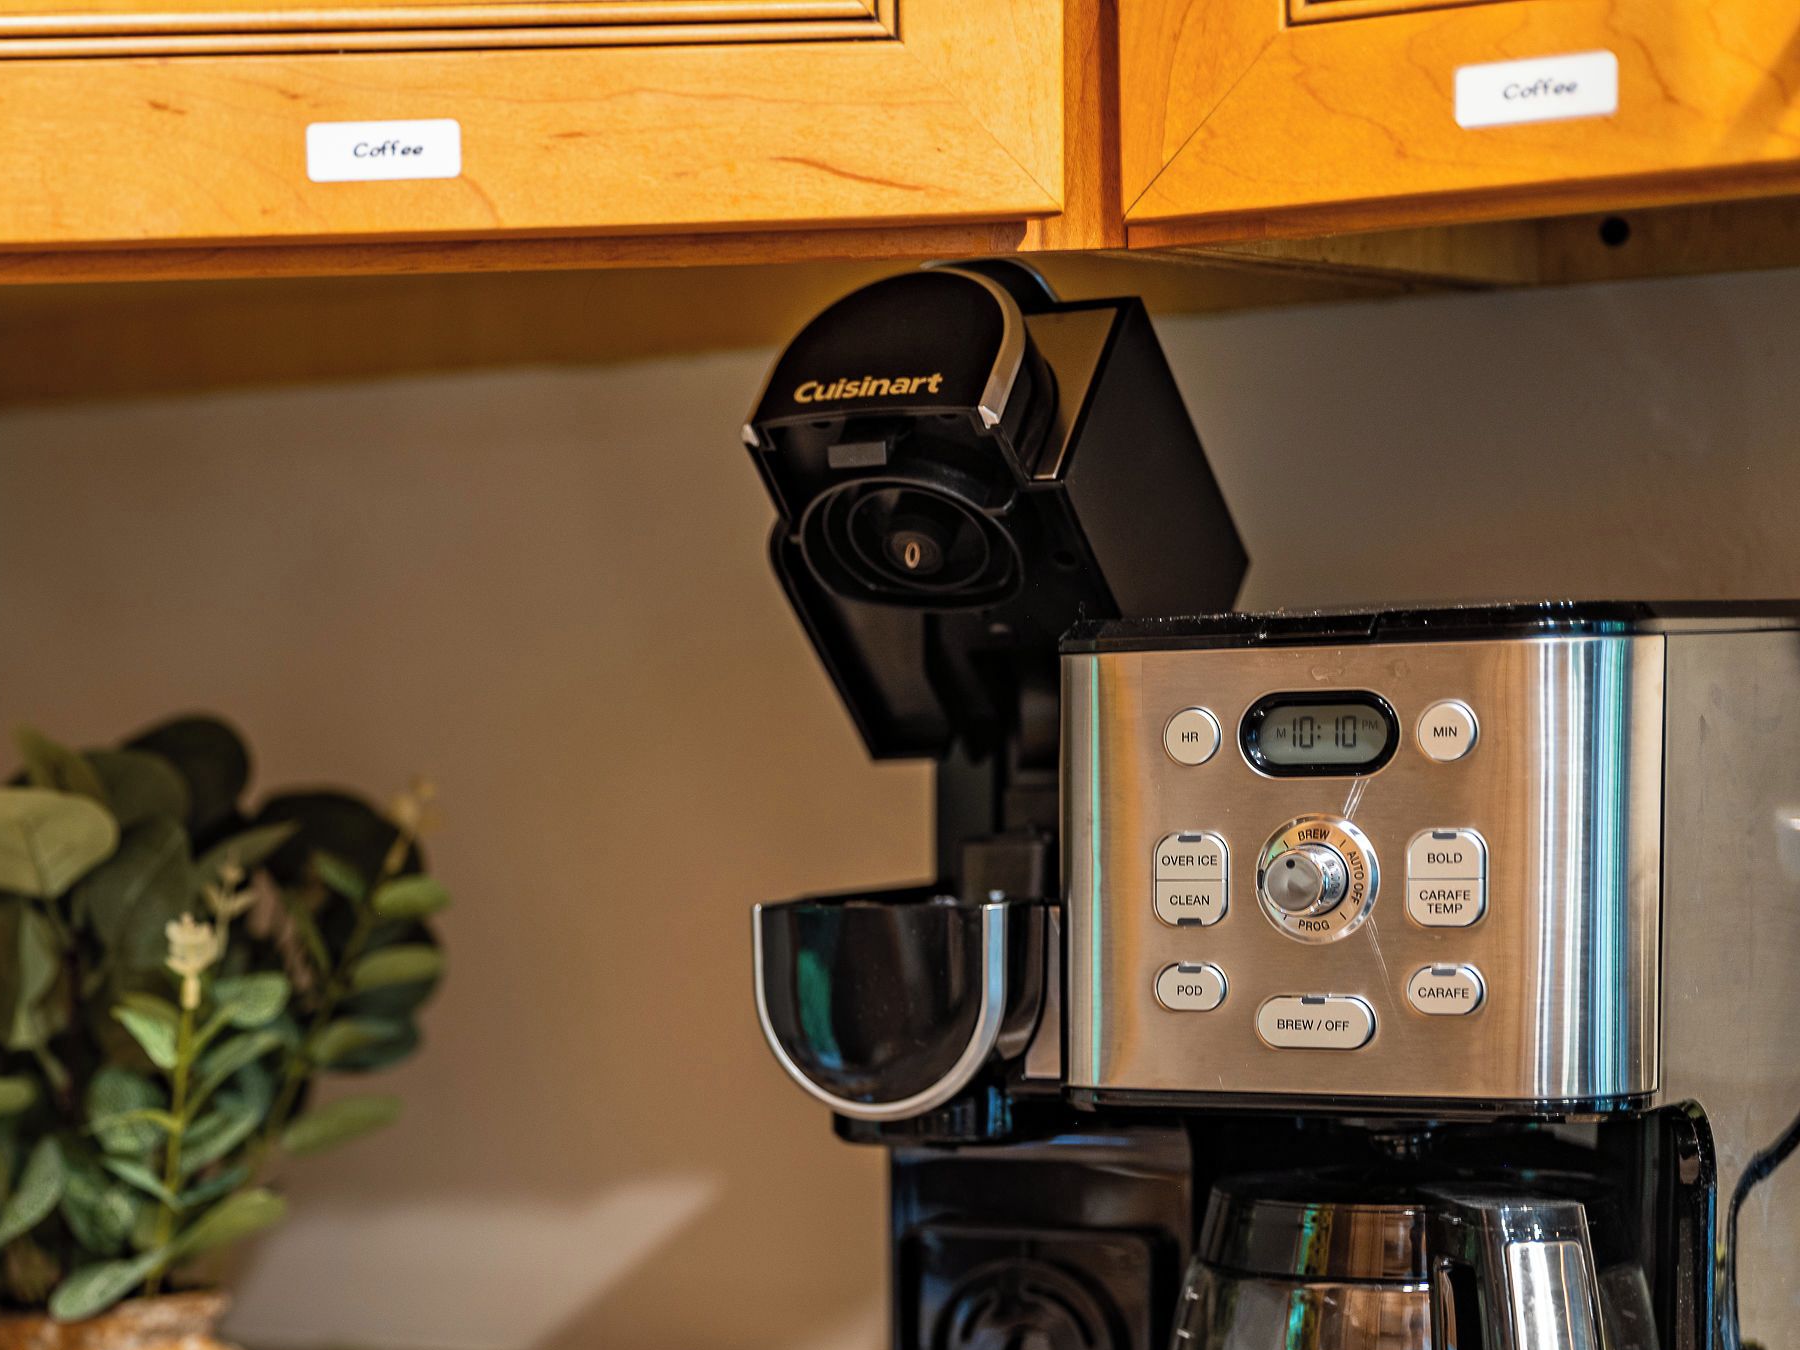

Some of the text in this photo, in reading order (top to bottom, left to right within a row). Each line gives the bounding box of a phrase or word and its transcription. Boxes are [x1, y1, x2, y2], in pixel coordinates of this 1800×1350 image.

[1503, 77, 1578, 100] Coffee
[353, 140, 423, 158] Coffee
[793, 372, 943, 404] Cuisinart
[1181, 731, 1199, 743] HR
[1293, 716, 1357, 748] 10:10
[1362, 719, 1378, 731] PM
[1433, 726, 1457, 739] MIN
[1297, 828, 1330, 841] BREW
[1161, 855, 1218, 867] OVER ICE
[1427, 852, 1463, 865] BOLD
[1347, 850, 1365, 905] AUTO OFF
[1169, 894, 1210, 907] CLEAN
[1419, 889, 1471, 902] CARAFE
[1427, 902, 1463, 915] TEMP
[1298, 919, 1330, 932] PROG
[1176, 984, 1204, 997] POD
[1417, 987, 1470, 1000] CARAFE
[1276, 1019, 1313, 1032] BREW
[1324, 1020, 1350, 1033] OFF
